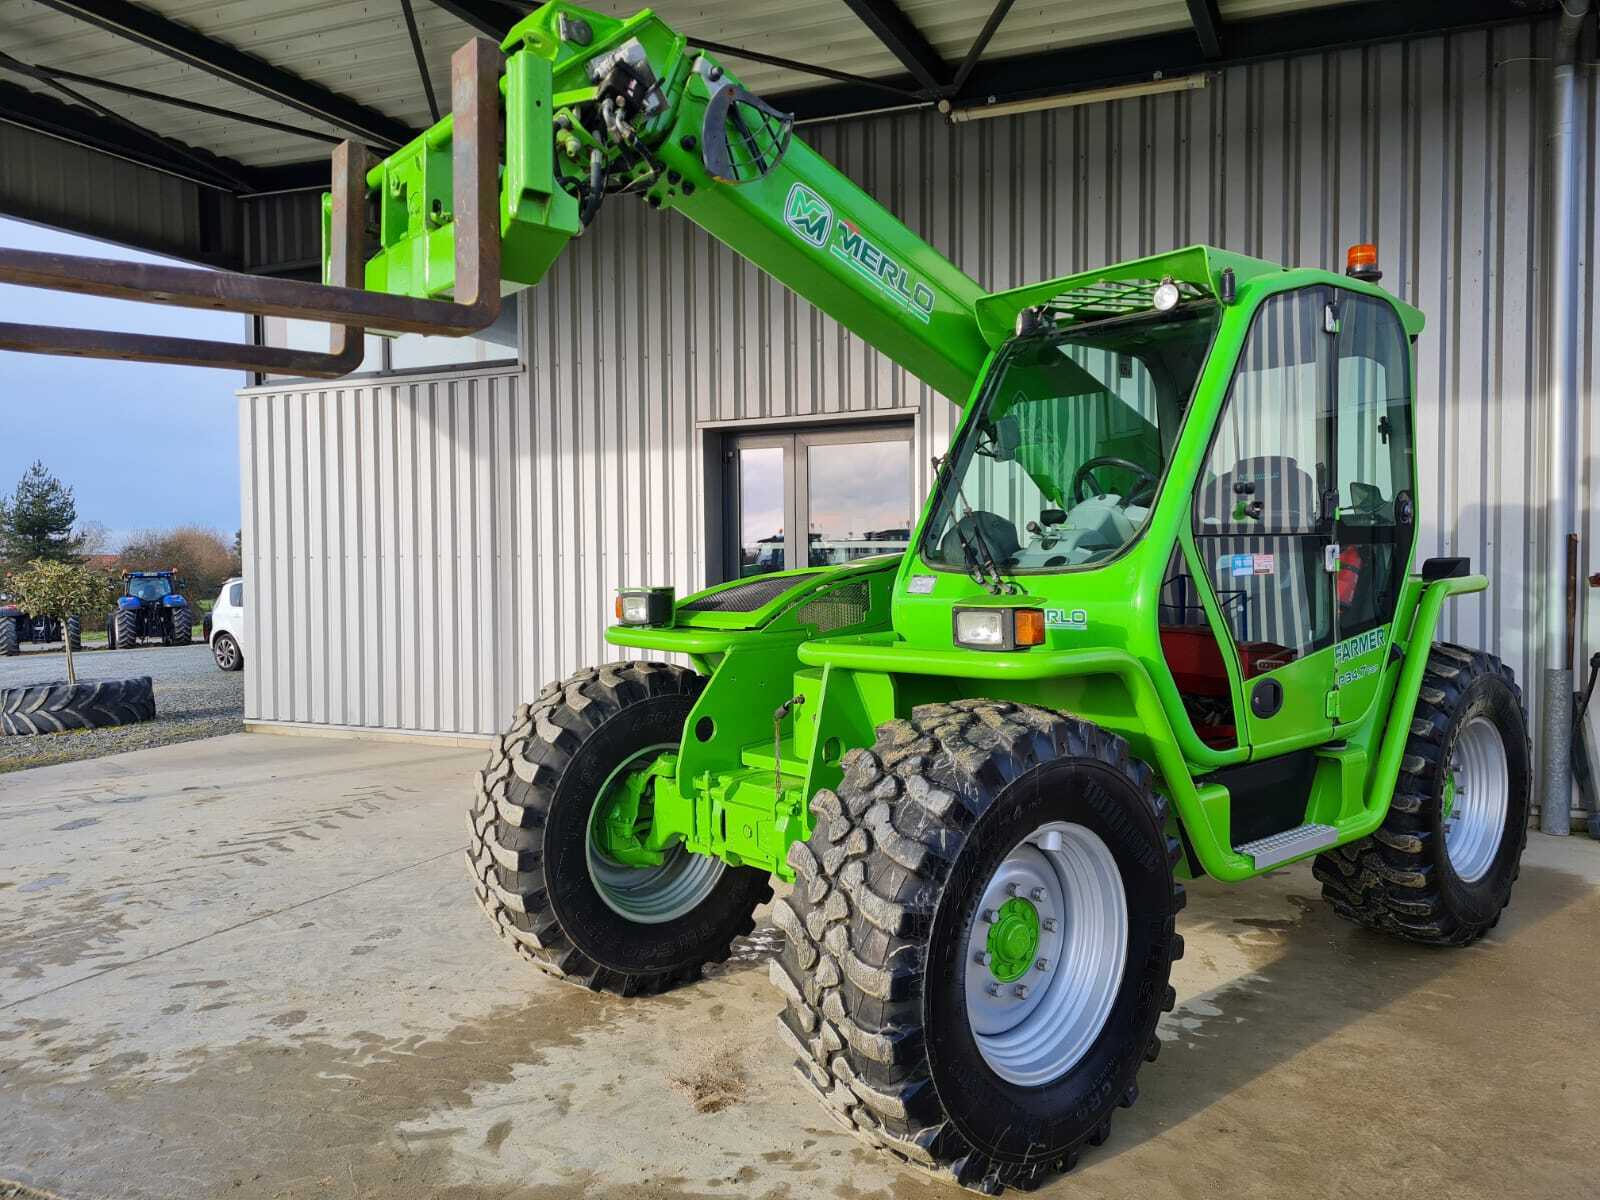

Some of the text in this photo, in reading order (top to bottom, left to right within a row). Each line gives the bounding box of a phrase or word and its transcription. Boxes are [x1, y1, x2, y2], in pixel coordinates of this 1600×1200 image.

[837, 219, 935, 312] MERLO
[1046, 609, 1086, 624] RLO
[1335, 629, 1385, 664] FARMER
